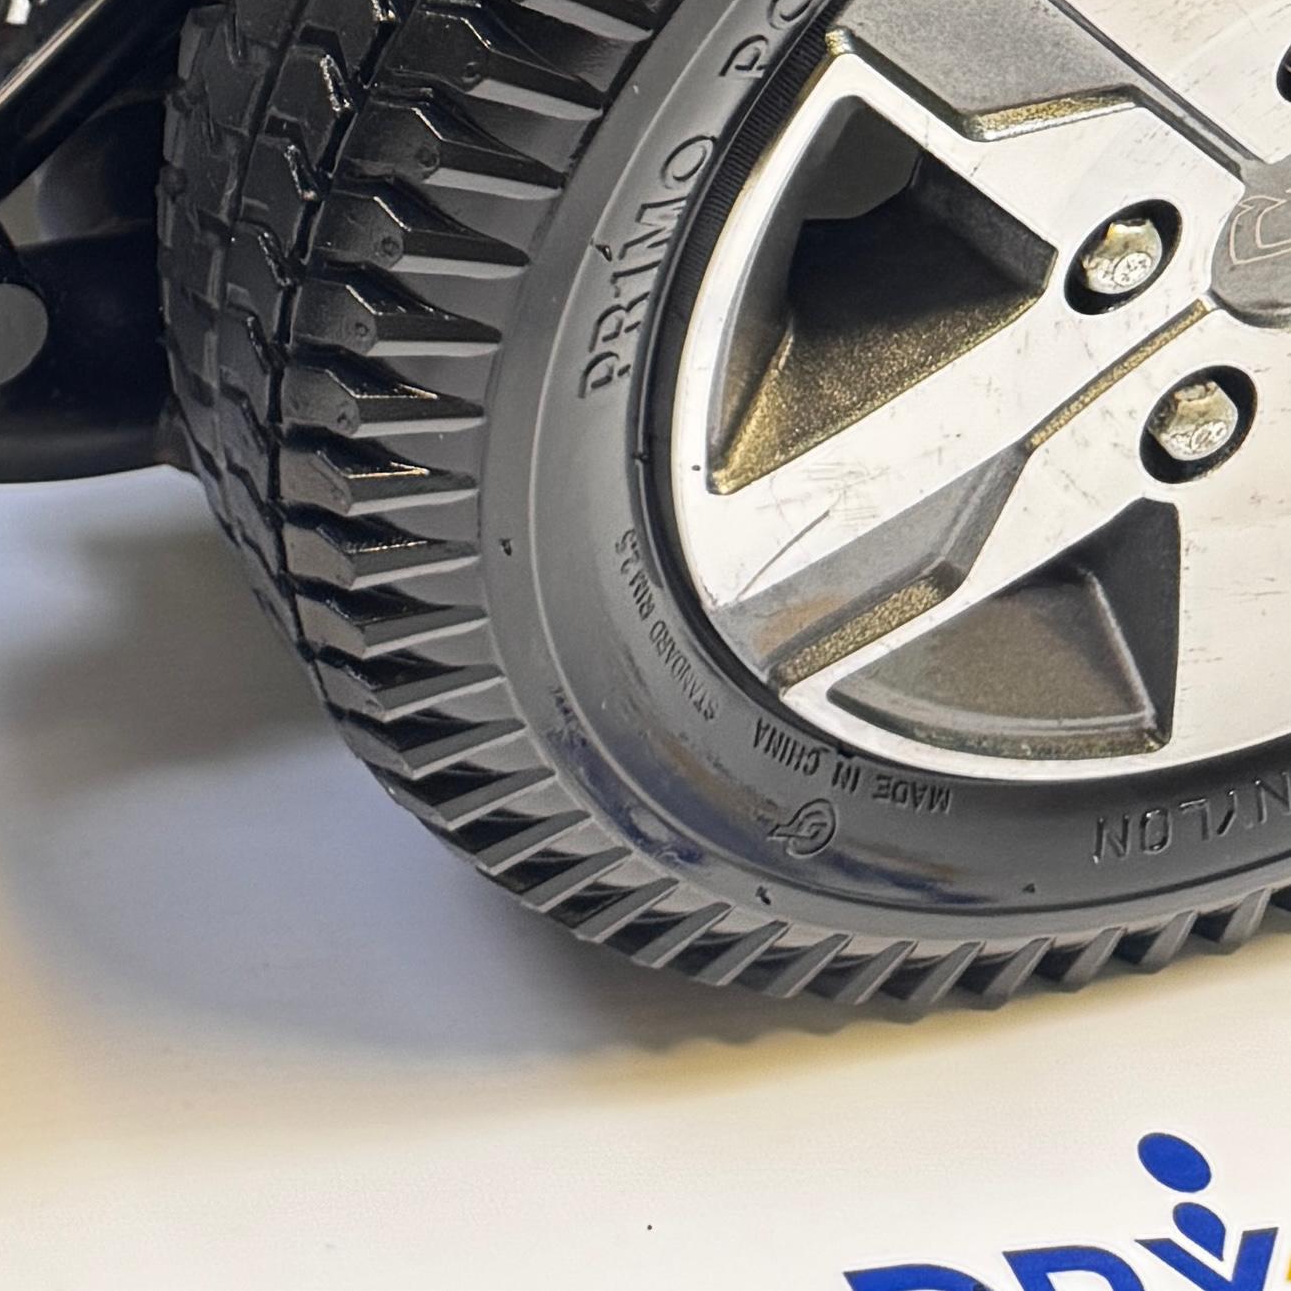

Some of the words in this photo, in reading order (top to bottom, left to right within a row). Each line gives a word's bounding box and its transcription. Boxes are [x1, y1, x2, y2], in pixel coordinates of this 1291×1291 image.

[577, 134, 717, 399] PRIMO
[649, 620, 718, 722] STANDARD
[752, 718, 822, 777] CHINA
[831, 761, 864, 793] IN
[873, 774, 952, 813] MADE
[1091, 770, 1291, 864] NYLON
